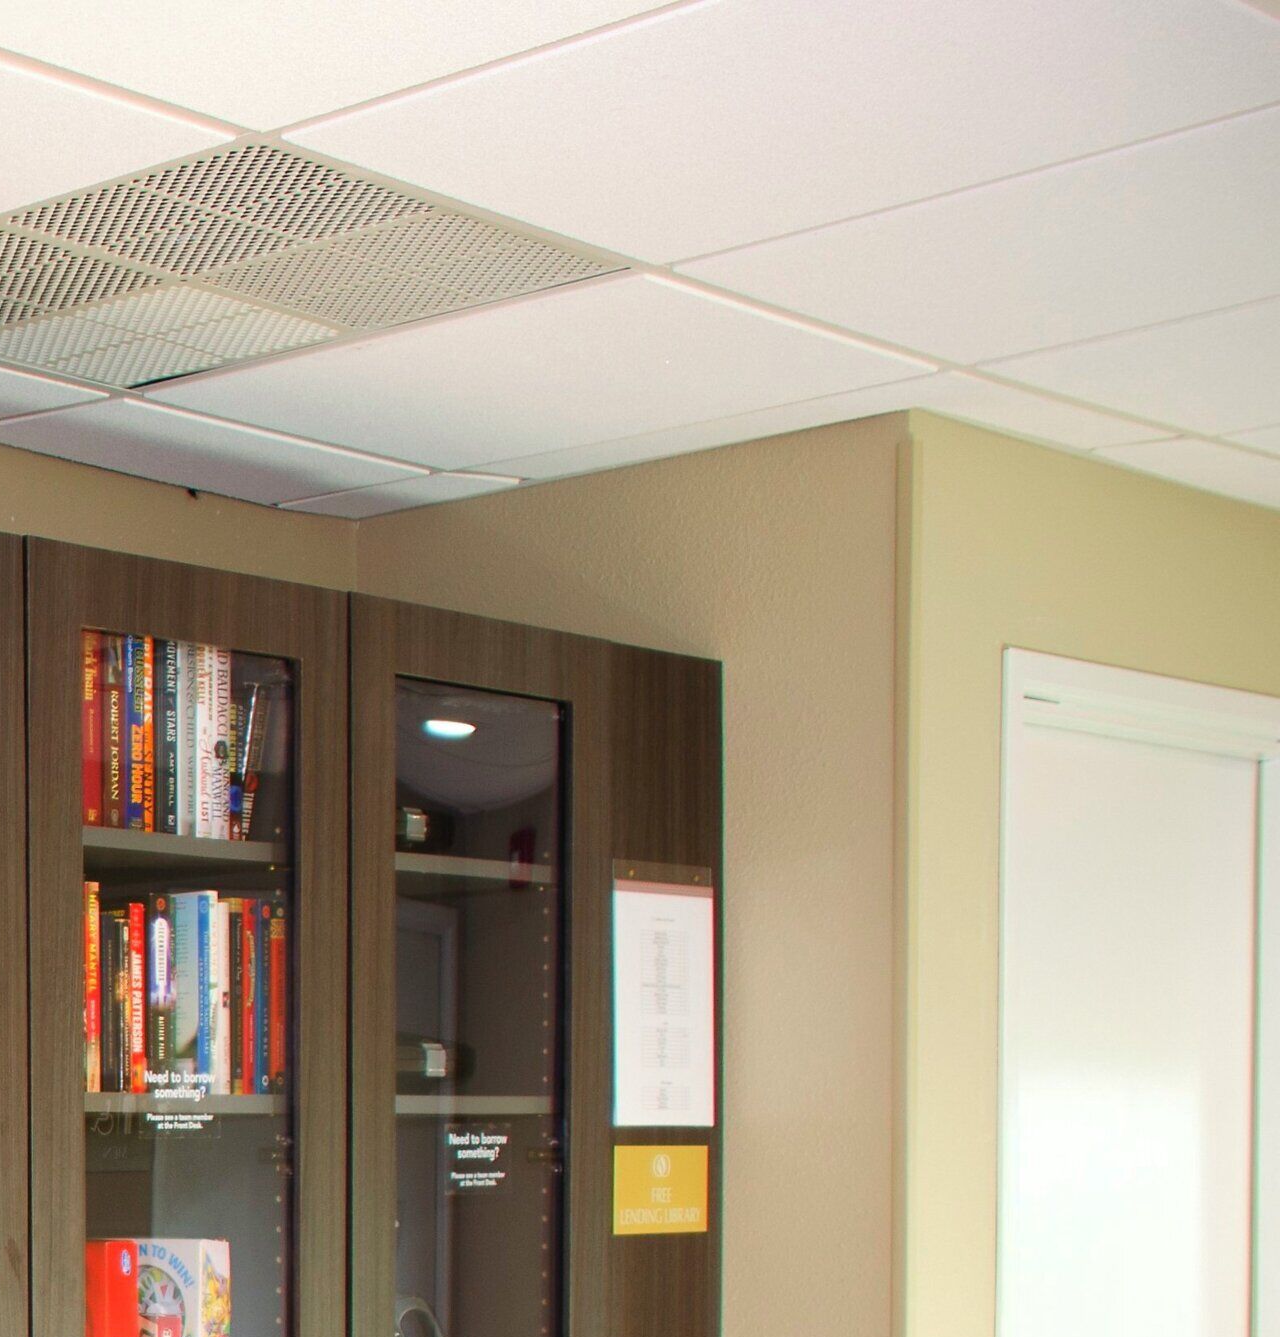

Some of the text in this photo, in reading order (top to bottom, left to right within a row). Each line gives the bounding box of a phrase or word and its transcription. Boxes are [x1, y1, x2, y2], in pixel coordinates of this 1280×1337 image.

[85, 668, 97, 701] Twain
[144, 663, 153, 724] CRAIS
[216, 669, 229, 738] BALDACCI
[110, 690, 119, 801] ROBERT JORDAN
[166, 710, 177, 743] STARS
[131, 724, 144, 804] ZERO HOUR
[201, 801, 209, 823] LIST
[211, 767, 222, 821] MAXWELL
[241, 793, 255, 835] TIMELINE
[88, 894, 98, 939] HILARY
[88, 943, 98, 993] MANTEL
[132, 951, 143, 1053] JAMES PATTERSON
[144, 1070, 215, 1083] Need to borrow
[154, 1086, 206, 1102] something?
[448, 1132, 508, 1145] Need to borrow
[457, 1146, 500, 1161] something?
[620, 1207, 701, 1225] LENDING LIBRARY
[651, 1187, 672, 1203] FREE
[139, 1244, 194, 1288] N TO WIN!
